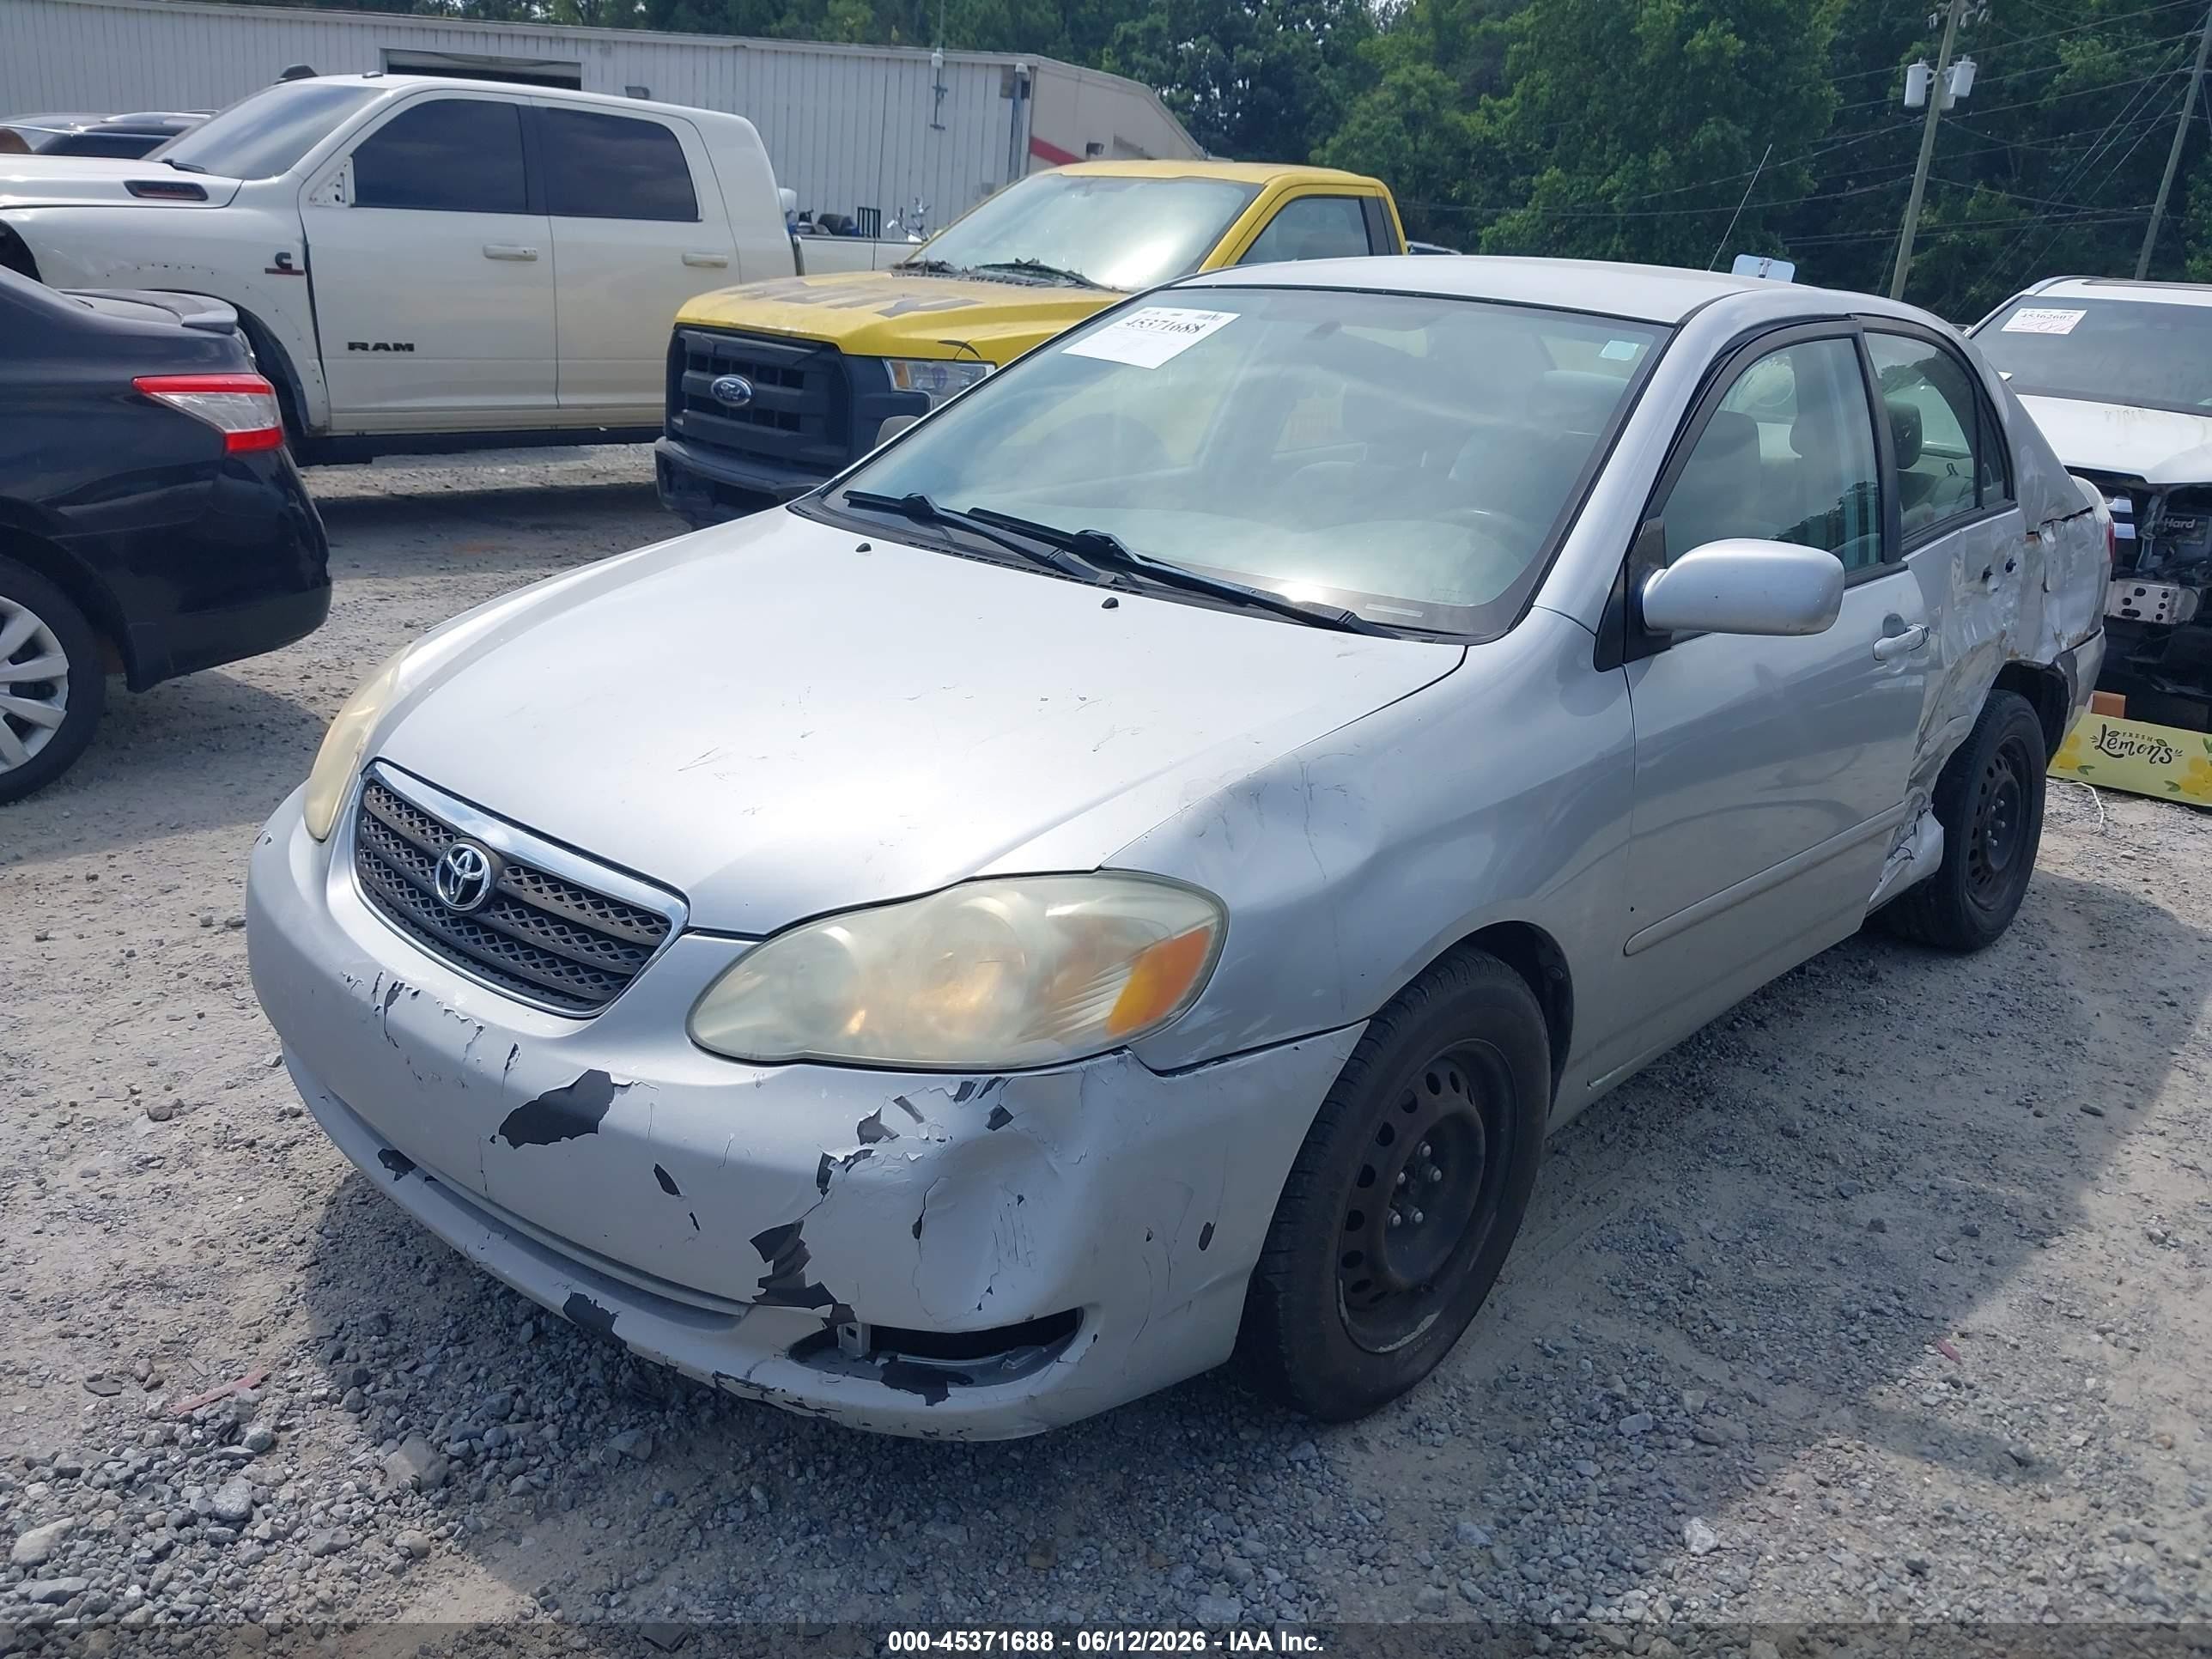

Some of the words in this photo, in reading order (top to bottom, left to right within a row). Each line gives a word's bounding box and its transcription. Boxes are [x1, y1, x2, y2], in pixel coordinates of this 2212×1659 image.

[1126, 319, 1206, 333] 45371688
[348, 342, 415, 352] RAM
[2122, 732, 2154, 742] FRESH
[2094, 723, 2173, 765] Lemons
